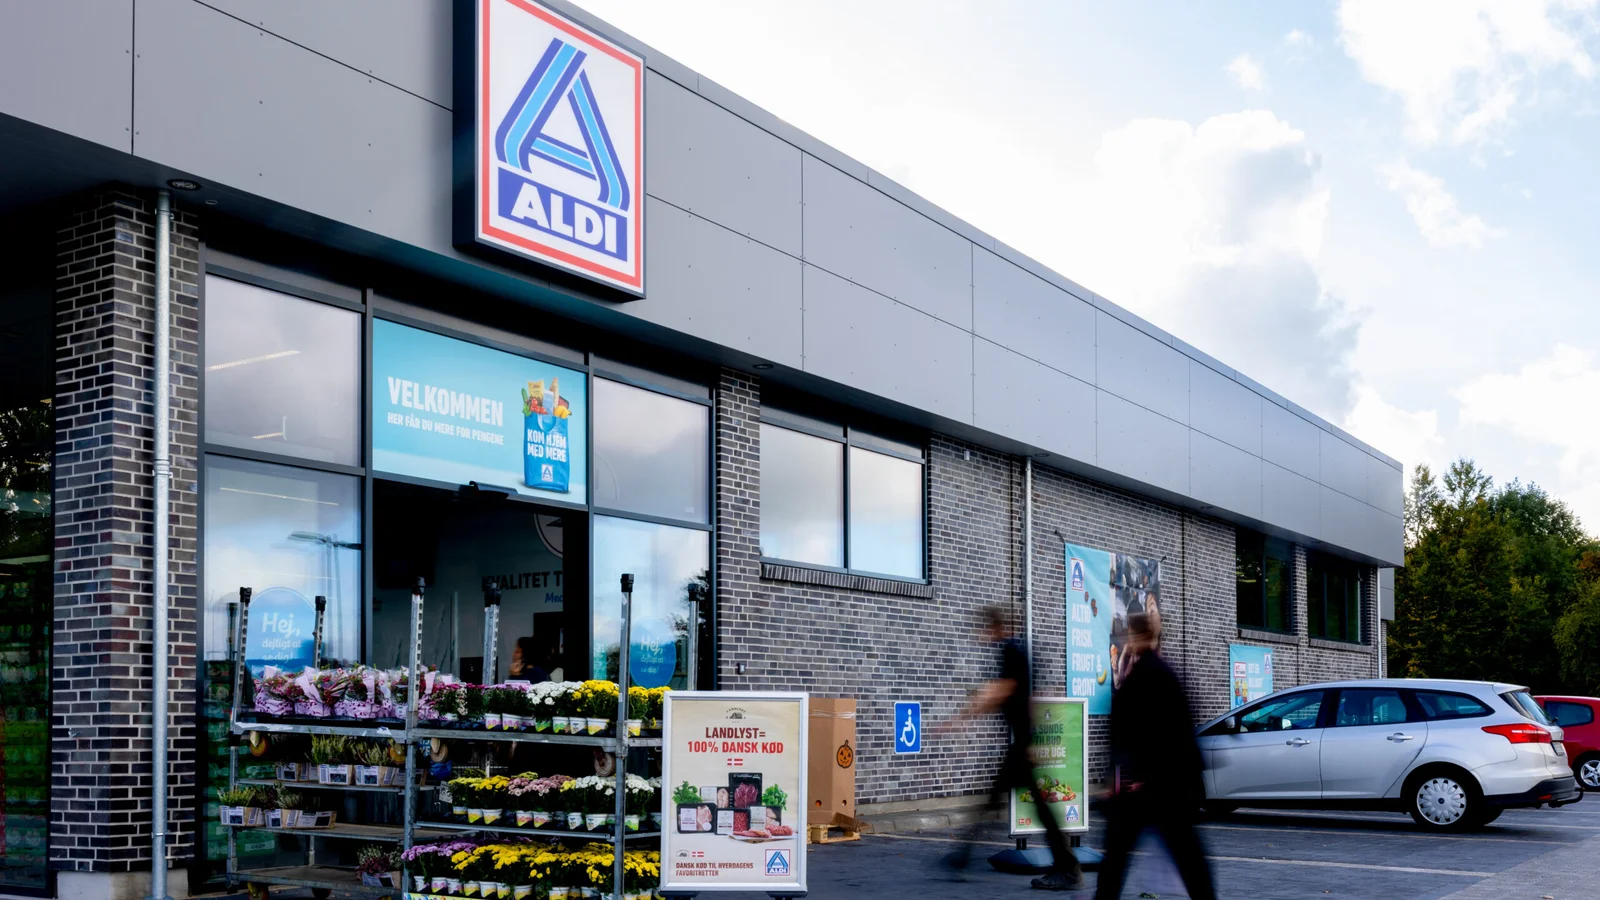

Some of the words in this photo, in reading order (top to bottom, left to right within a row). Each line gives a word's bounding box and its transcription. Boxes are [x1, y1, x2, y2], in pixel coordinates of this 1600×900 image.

[511, 182, 617, 254] ALDI
[387, 376, 504, 427] VELKOMMEN
[387, 412, 403, 426] HER
[405, 413, 420, 429] FÅR
[422, 419, 433, 431] DU
[434, 422, 454, 436] MERE
[456, 426, 471, 439] FOR
[472, 429, 504, 445] PENGENE
[527, 428, 545, 444] KOM
[546, 433, 567, 449] HJEM
[527, 442, 544, 458] MED
[546, 446, 567, 462] MERE
[1071, 603, 1091, 624] ALTID
[262, 612, 301, 638] Hej,
[262, 639, 291, 649] dejligt
[641, 635, 663, 654] Hej,
[1071, 628, 1092, 648] FRISK
[1071, 652, 1095, 673] FRUGT
[1071, 677, 1096, 697] GRØNT
[705, 727, 766, 739] LANDLYST=
[1038, 724, 1064, 734] SUNDE
[688, 741, 719, 753] 100%
[721, 741, 758, 753] DANSK
[761, 741, 784, 754] KØD
[1052, 747, 1066, 758] UGE
[676, 869, 719, 877] FAVORITRETTER
